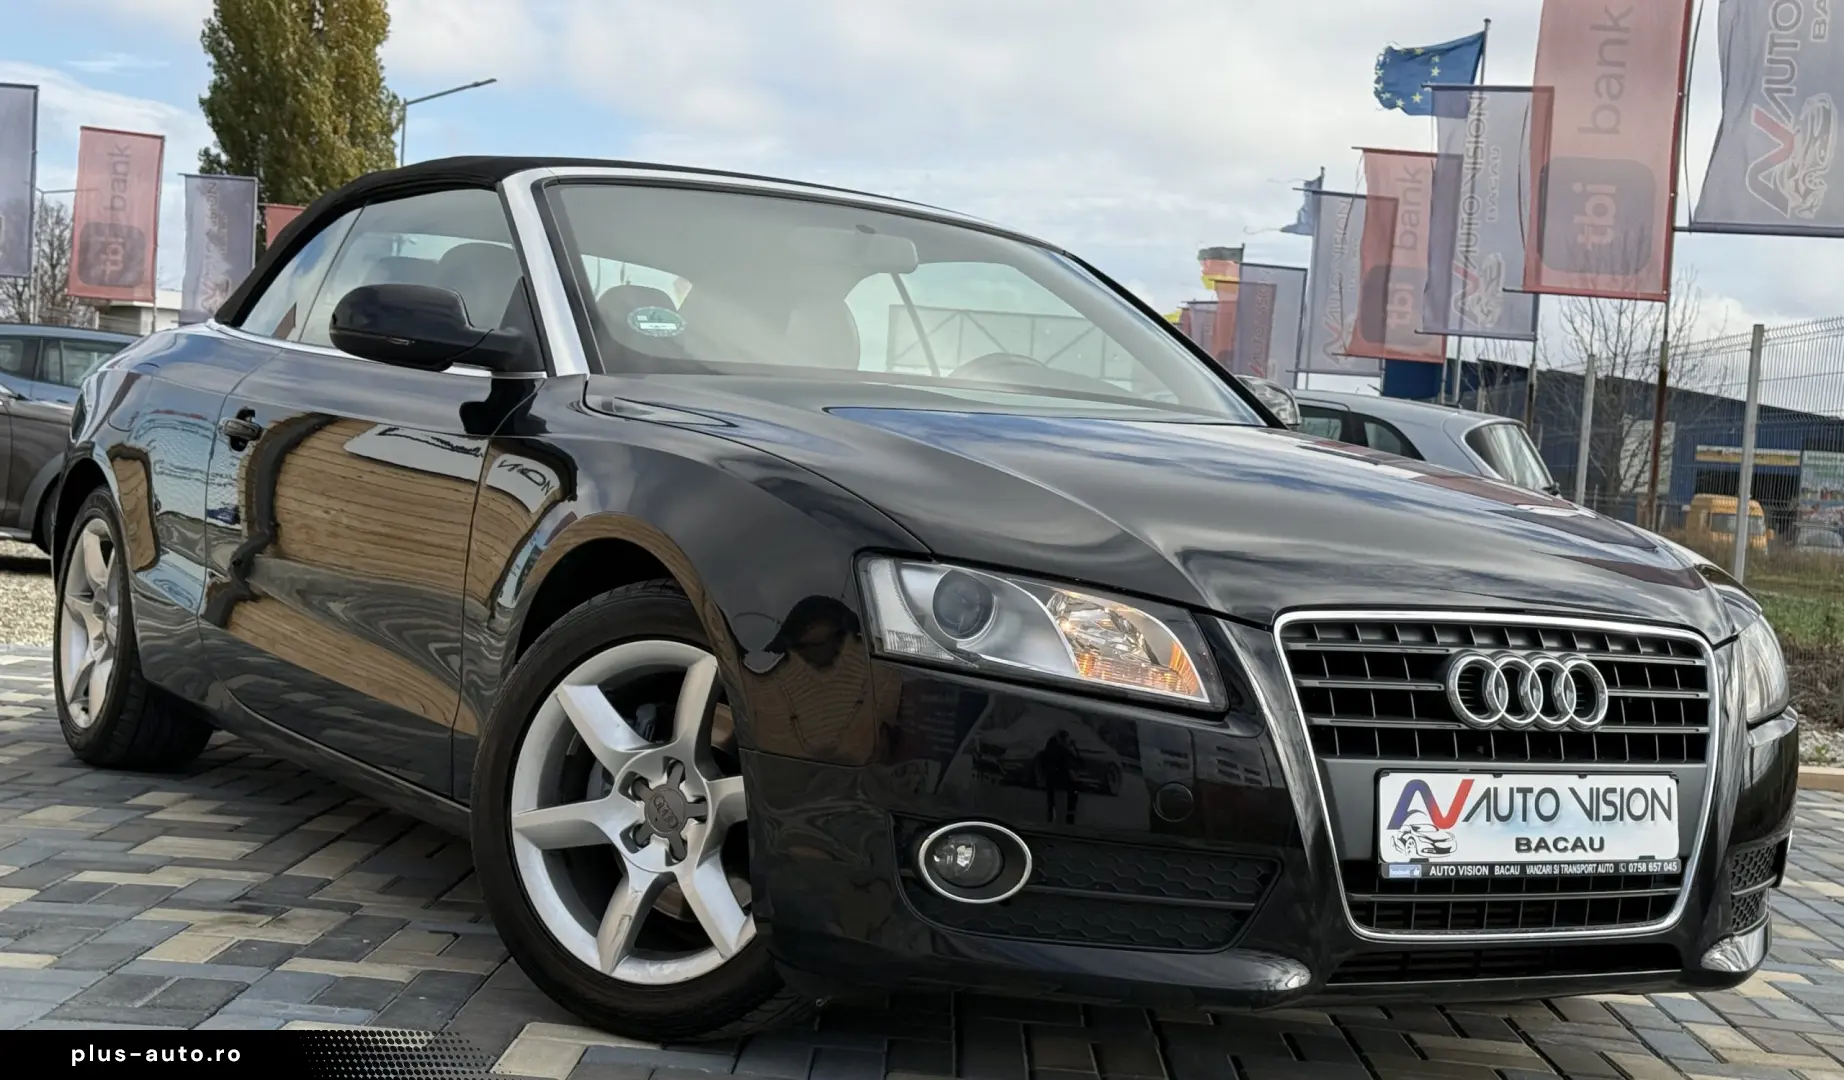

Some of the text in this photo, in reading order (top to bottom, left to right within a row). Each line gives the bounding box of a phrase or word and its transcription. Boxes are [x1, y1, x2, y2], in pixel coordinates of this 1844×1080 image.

[1762, 0, 1803, 129] AUTO
[1463, 94, 1487, 187] VISION
[1572, 4, 1633, 247] tbi bank
[104, 143, 132, 212] bank
[1394, 164, 1424, 254] bank
[1457, 194, 1481, 270] AUTO
[1462, 787, 1560, 822] AUTO
[1568, 787, 1672, 822] VISION
[1429, 865, 1456, 876] AUTO
[1458, 865, 1489, 876] VISION
[1494, 864, 1520, 875] BACAU
[1525, 864, 1552, 875] VANZARI
[1560, 863, 1597, 874] TRANSPORT
[1597, 863, 1615, 873] AUTO
[1628, 862, 1646, 872] 0758
[1663, 861, 1677, 872] 045
[1515, 836, 1606, 853] BACAU
